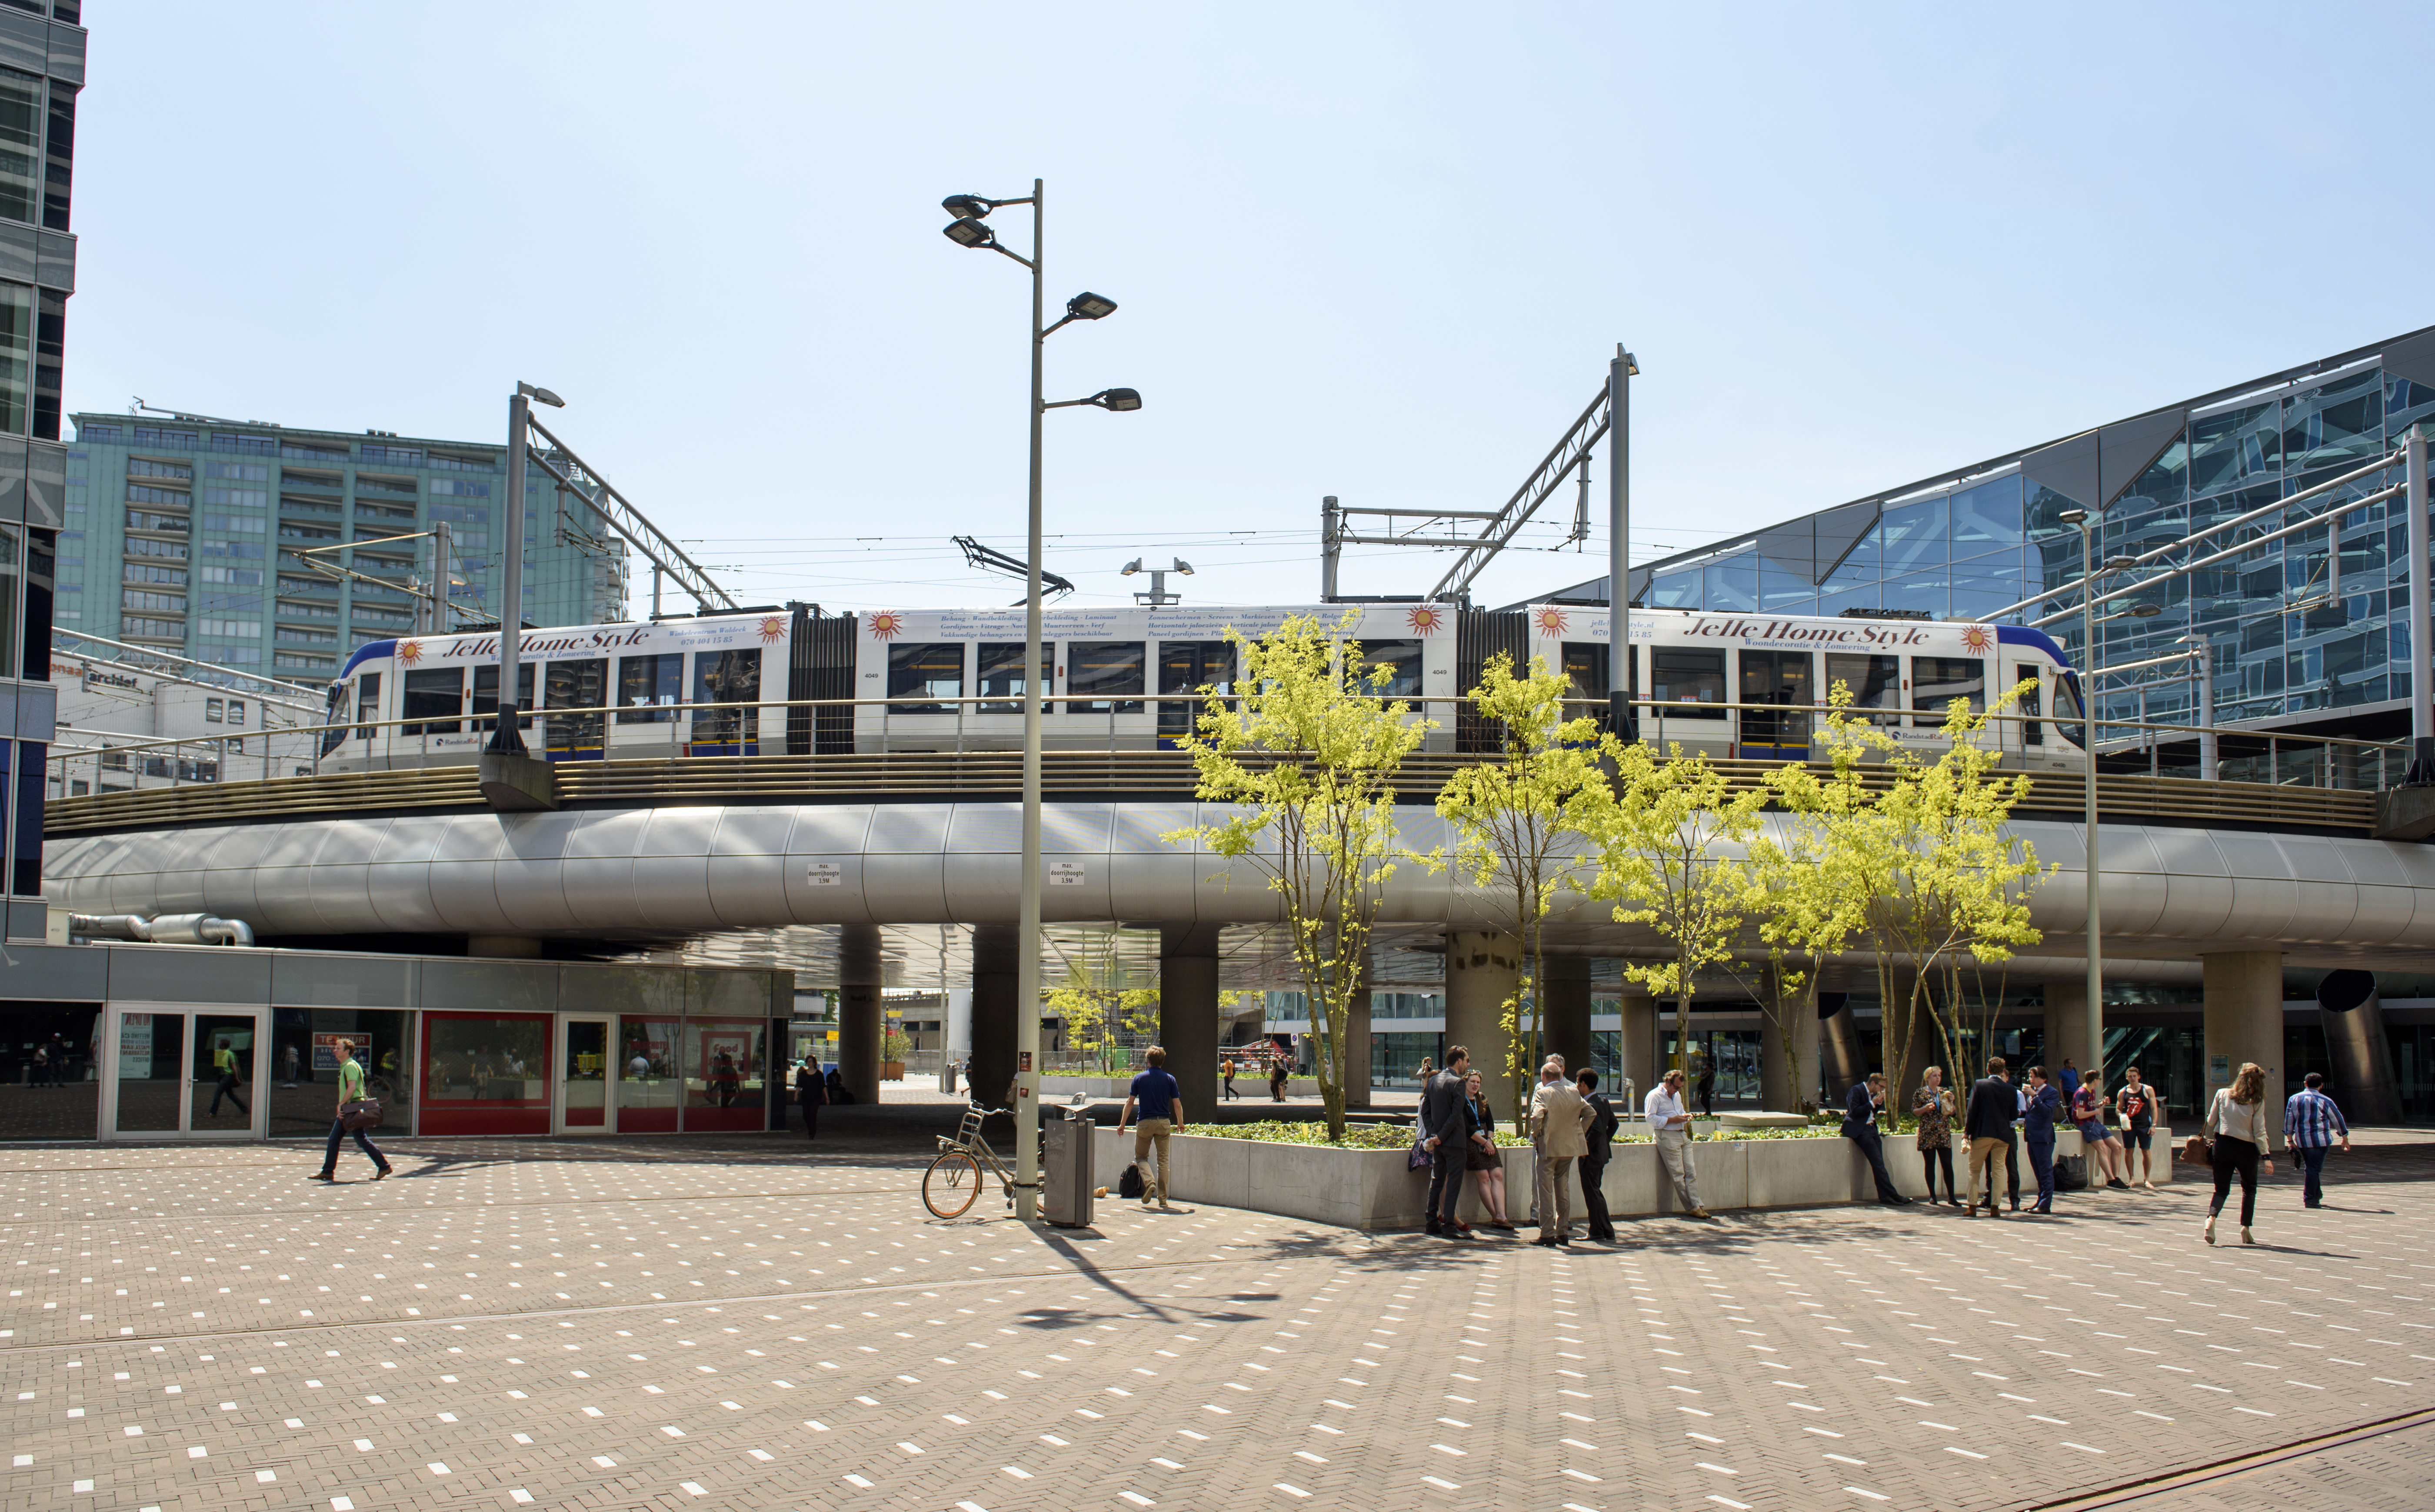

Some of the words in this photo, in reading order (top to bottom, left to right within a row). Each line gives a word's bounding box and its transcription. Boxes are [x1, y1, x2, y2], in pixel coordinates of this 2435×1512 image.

[585, 628, 650, 653] Style
[1683, 618, 1758, 638] Jelle
[1759, 621, 1854, 641] Home
[1856, 626, 1929, 649] Style
[556, 649, 596, 658] Zonwering
[1745, 638, 1811, 648] Woondecoratie
[1825, 641, 1871, 652] Zonwering
